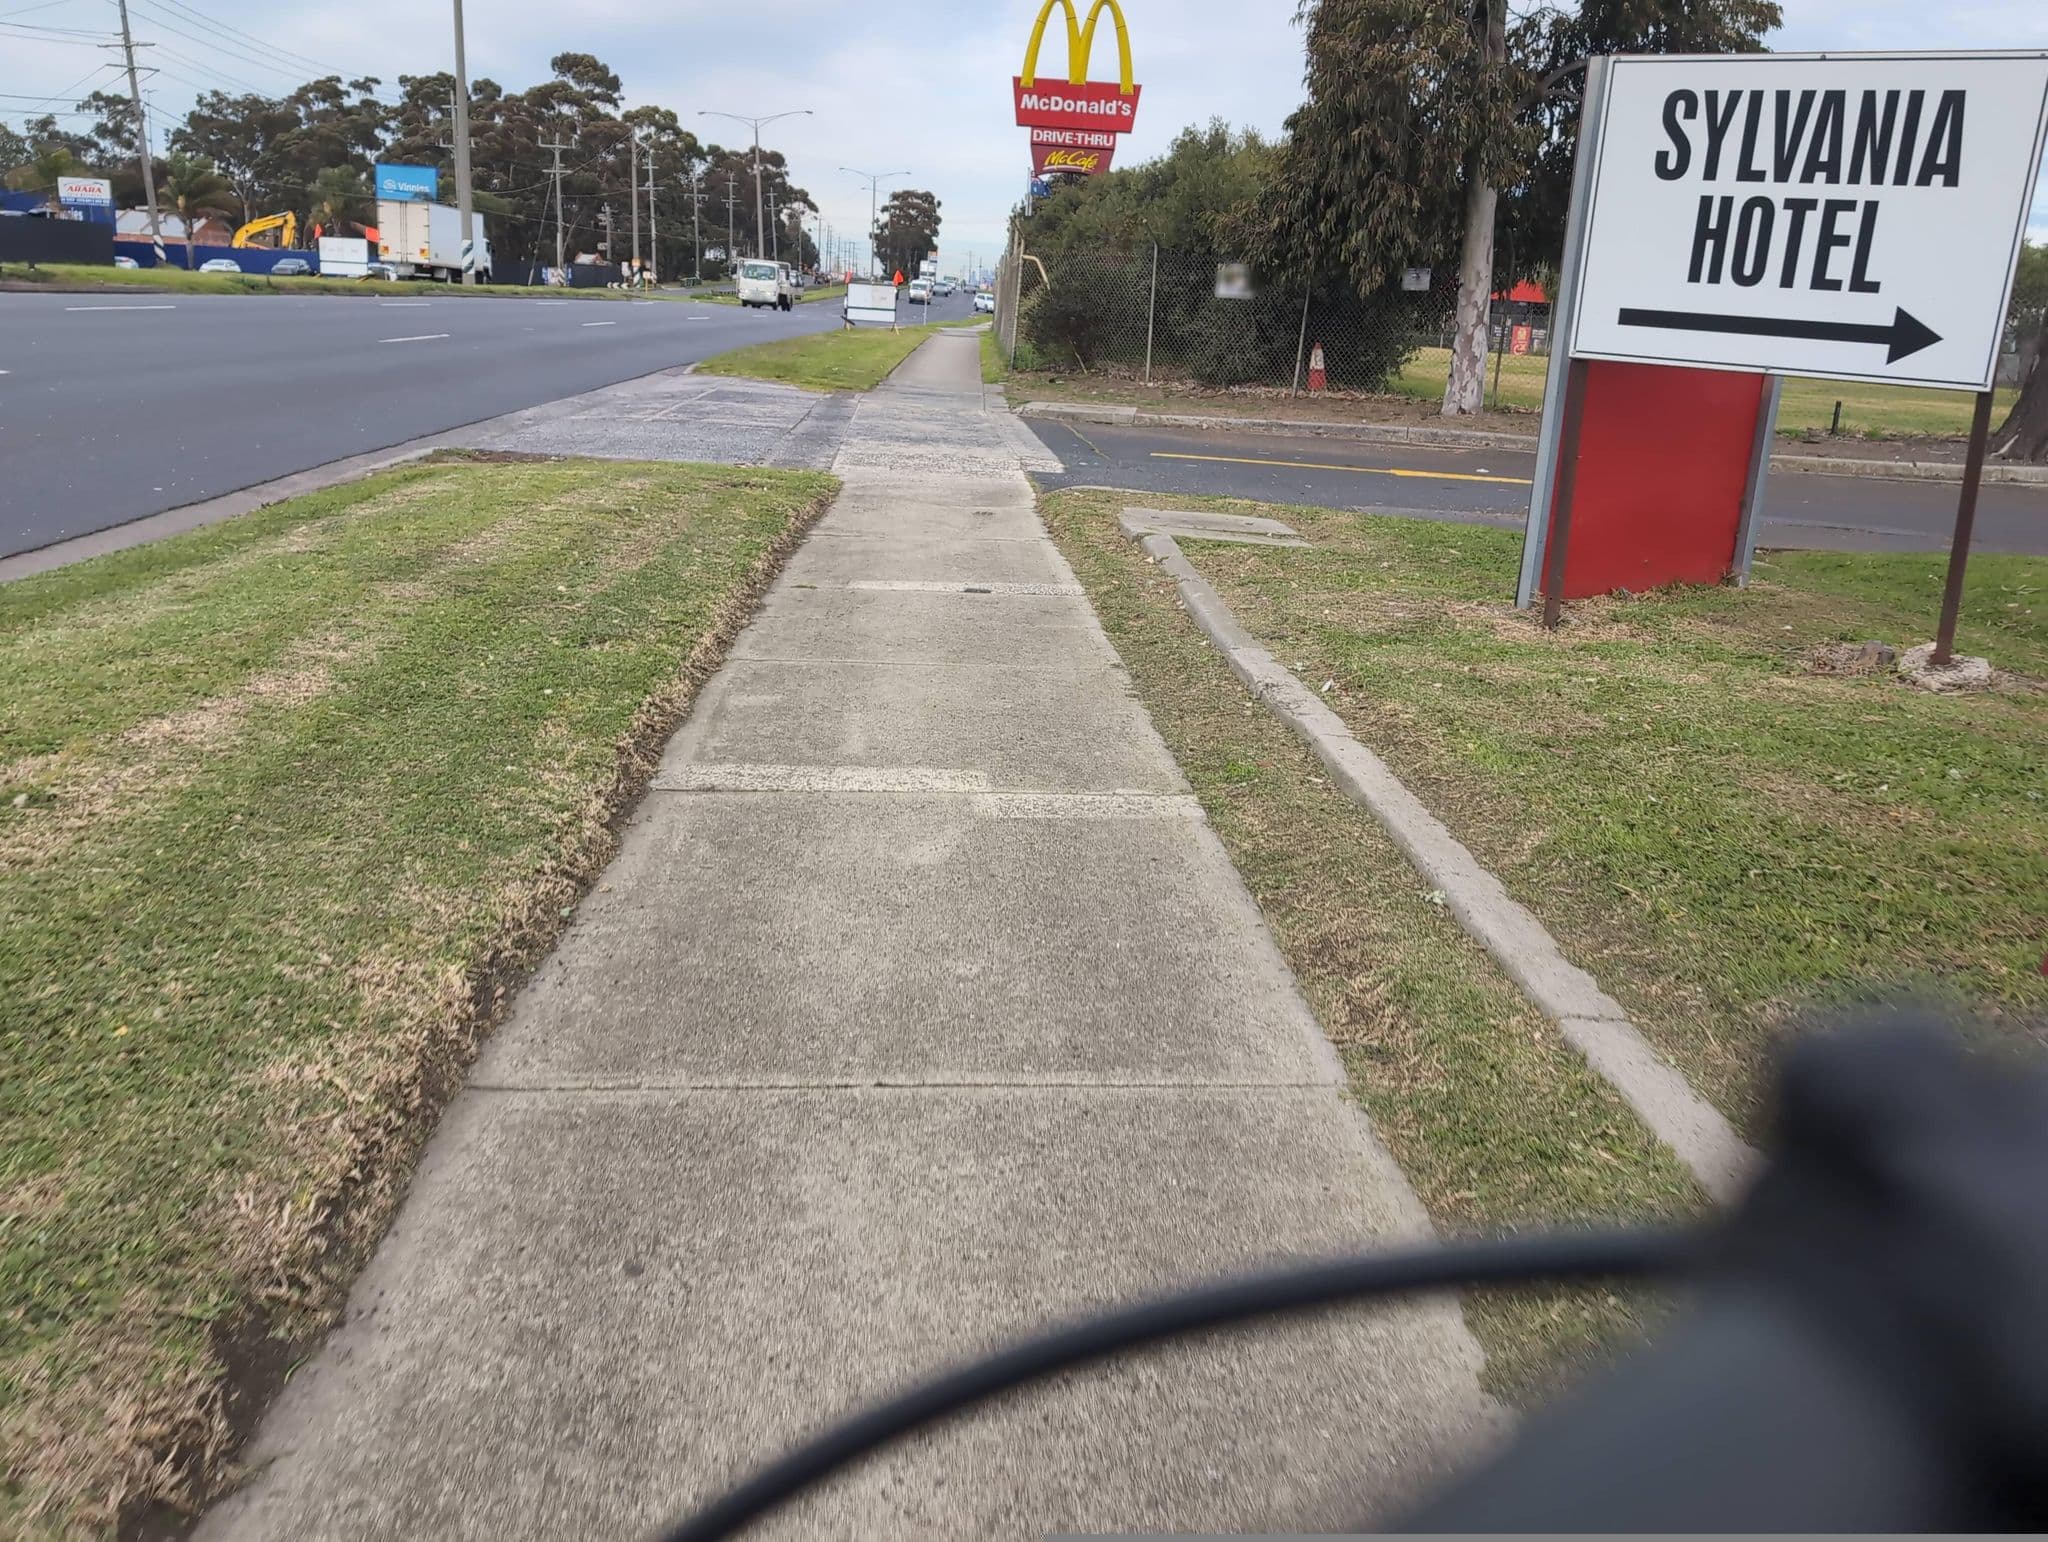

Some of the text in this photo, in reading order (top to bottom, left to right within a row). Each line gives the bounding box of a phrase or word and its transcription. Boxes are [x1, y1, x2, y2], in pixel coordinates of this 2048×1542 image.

[1020, 93, 1132, 116] McDonald's
[1032, 129, 1114, 147] DRIVE-THRU
[1654, 88, 1967, 188] SYLVANIA
[1687, 195, 1881, 293] HOTEL
